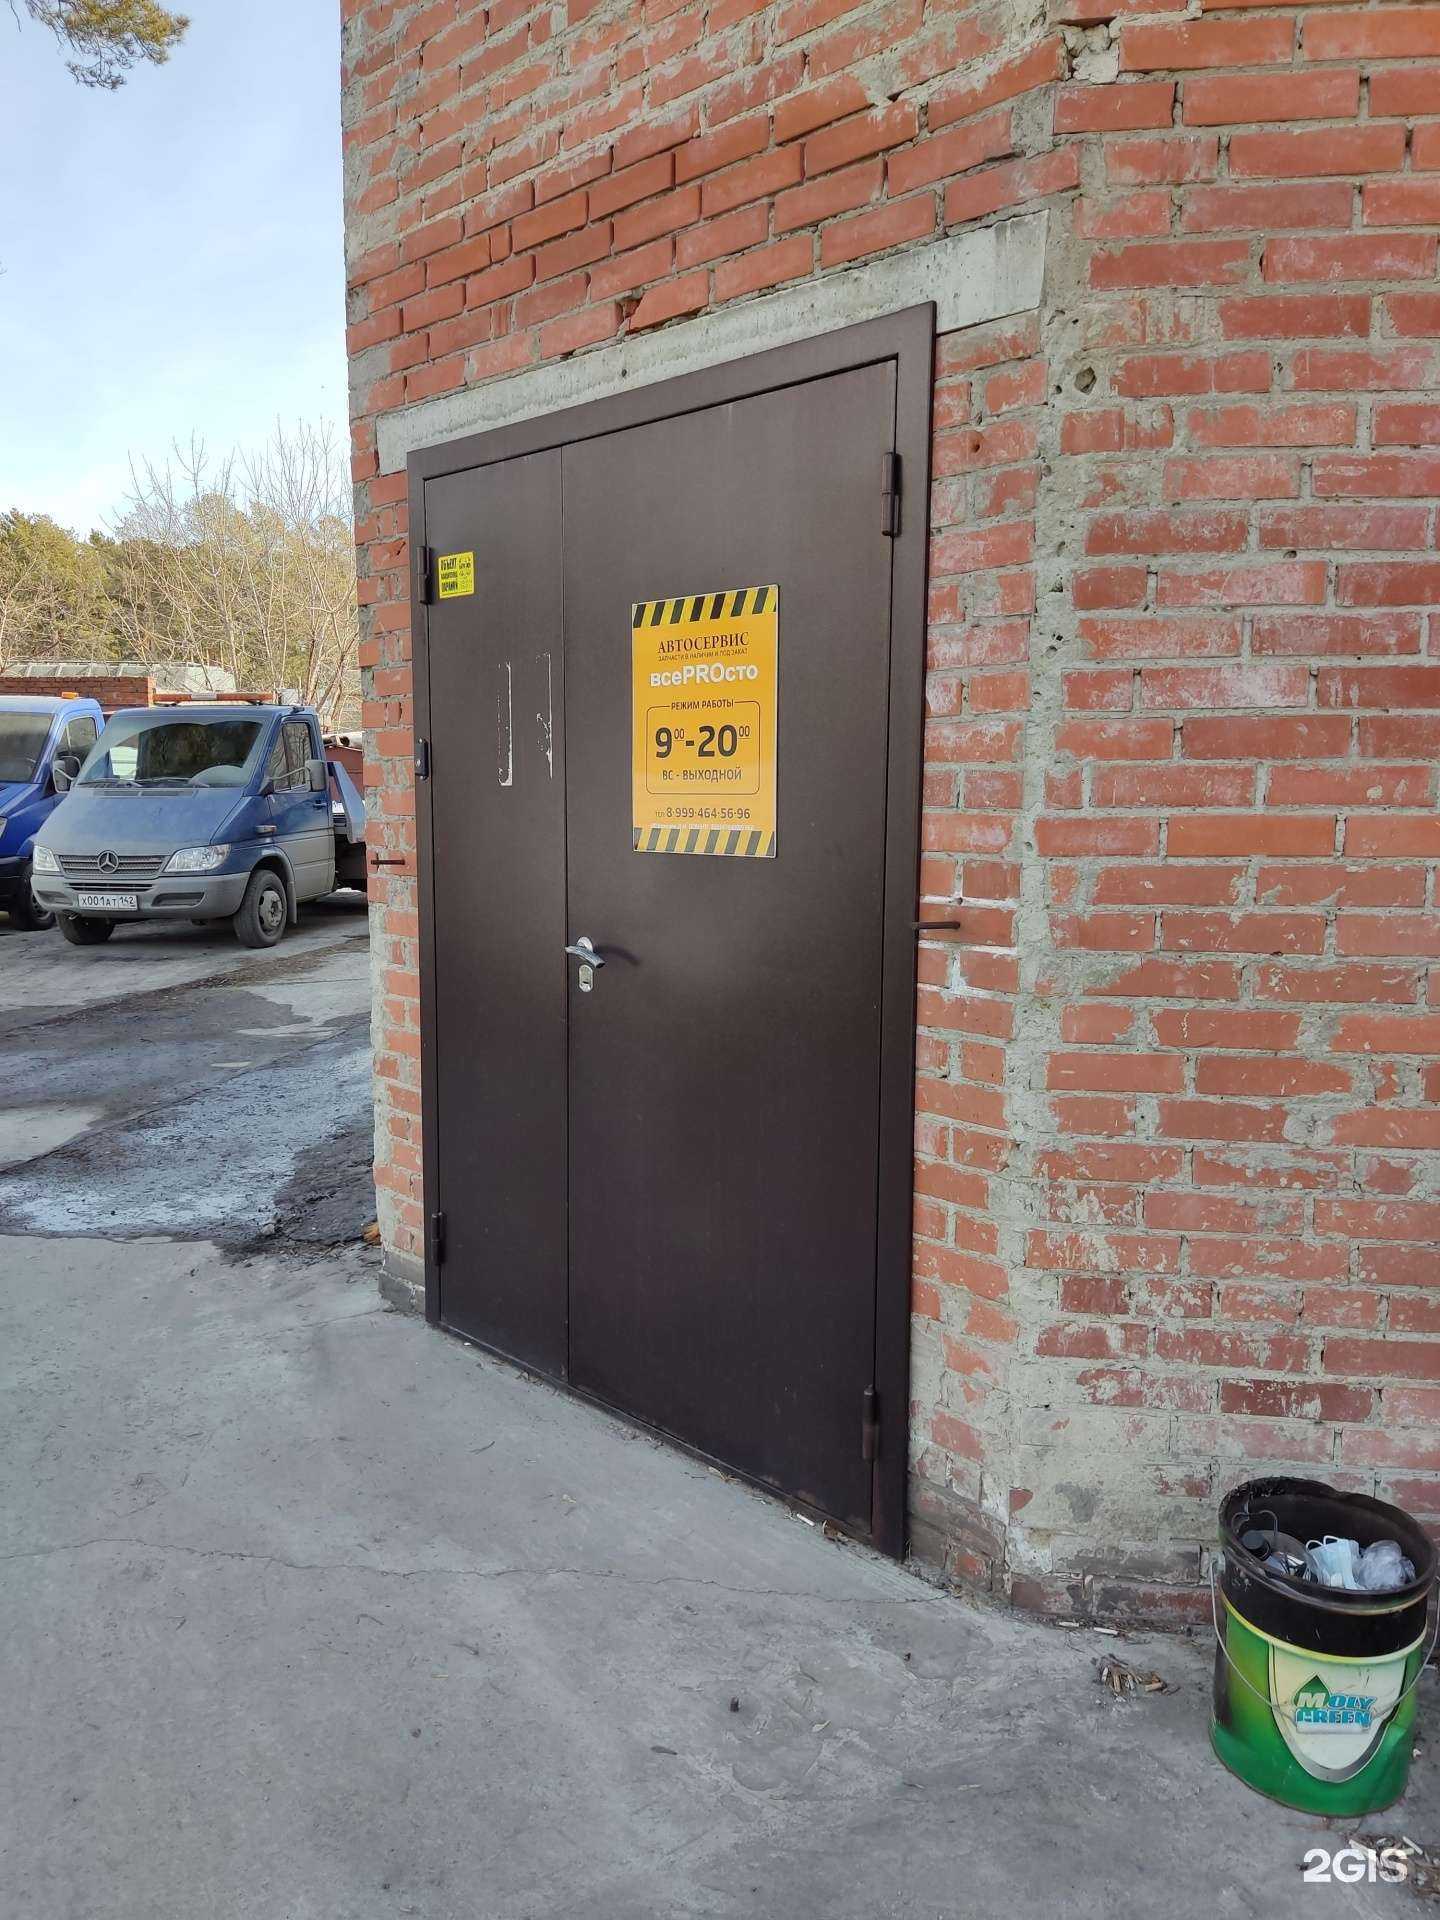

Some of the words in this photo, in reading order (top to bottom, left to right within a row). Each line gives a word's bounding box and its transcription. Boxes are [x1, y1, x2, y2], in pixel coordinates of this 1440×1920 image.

[658, 632, 749, 653] АВТОСЕРВИС
[671, 701, 700, 710] РЕЖИМ
[702, 699, 734, 709] РАБОТЫ
[662, 770, 673, 780] ВС
[682, 766, 742, 782] ВЫХОДНОЙ
[1297, 1692, 1377, 1709] MOLY
[1295, 1708, 1372, 1729] GREEN
